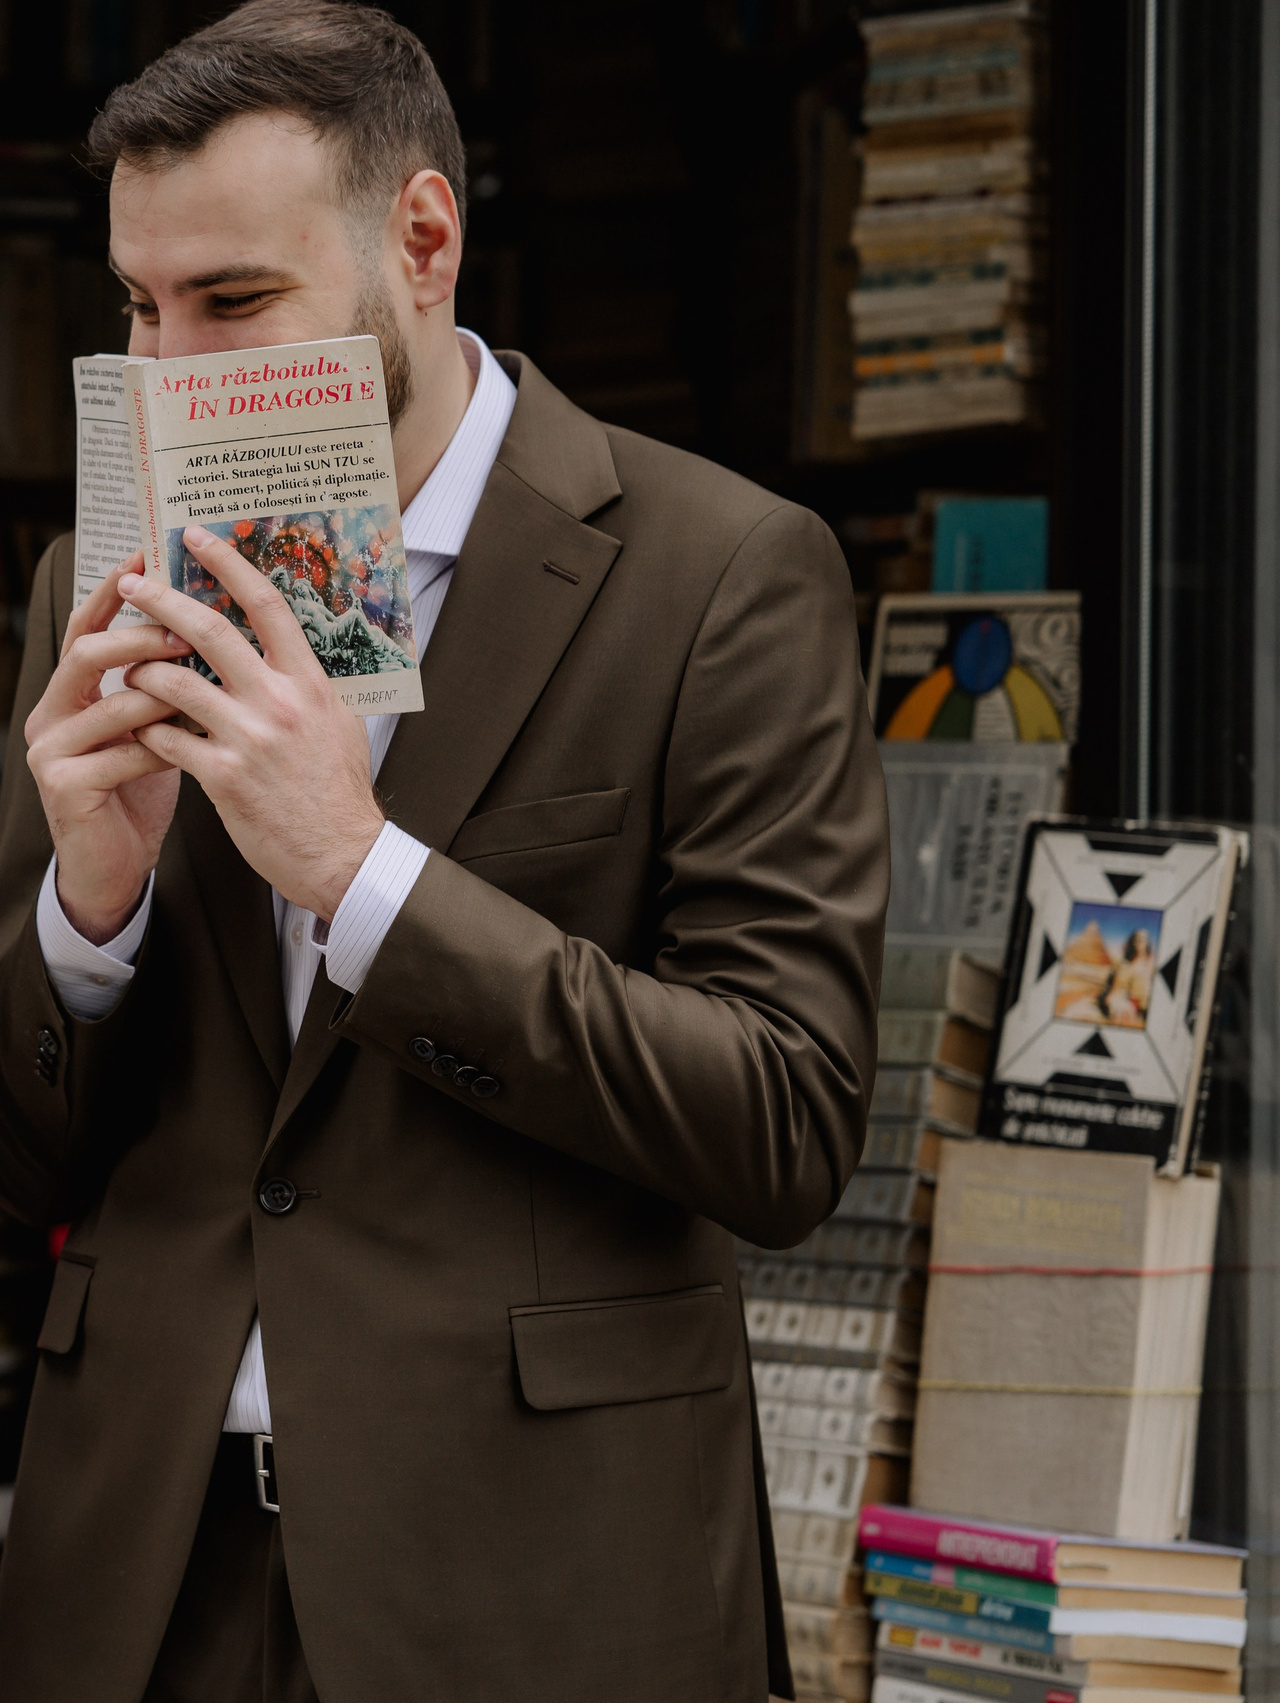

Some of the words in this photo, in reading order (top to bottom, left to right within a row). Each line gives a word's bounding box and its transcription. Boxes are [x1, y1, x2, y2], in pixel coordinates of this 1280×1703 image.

[155, 375, 212, 395] Arta
[188, 396, 220, 421] ÎN
[227, 380, 374, 416] DRAGOSTE
[134, 388, 148, 455] DRAGOSTE
[186, 455, 218, 468] ARTA
[222, 445, 301, 464] RĂZBOIULUI
[305, 444, 327, 454] este
[177, 471, 229, 486] victoriei.
[232, 465, 283, 479] Strategia
[286, 462, 301, 473] lui
[304, 458, 331, 471] SUN
[334, 455, 359, 467] TZU
[363, 456, 375, 465] se
[167, 490, 201, 506] aplică
[204, 489, 215, 499] în
[266, 478, 309, 494] politică
[227, 502, 240, 512] să
[243, 502, 250, 510] o
[305, 493, 316, 503] în
